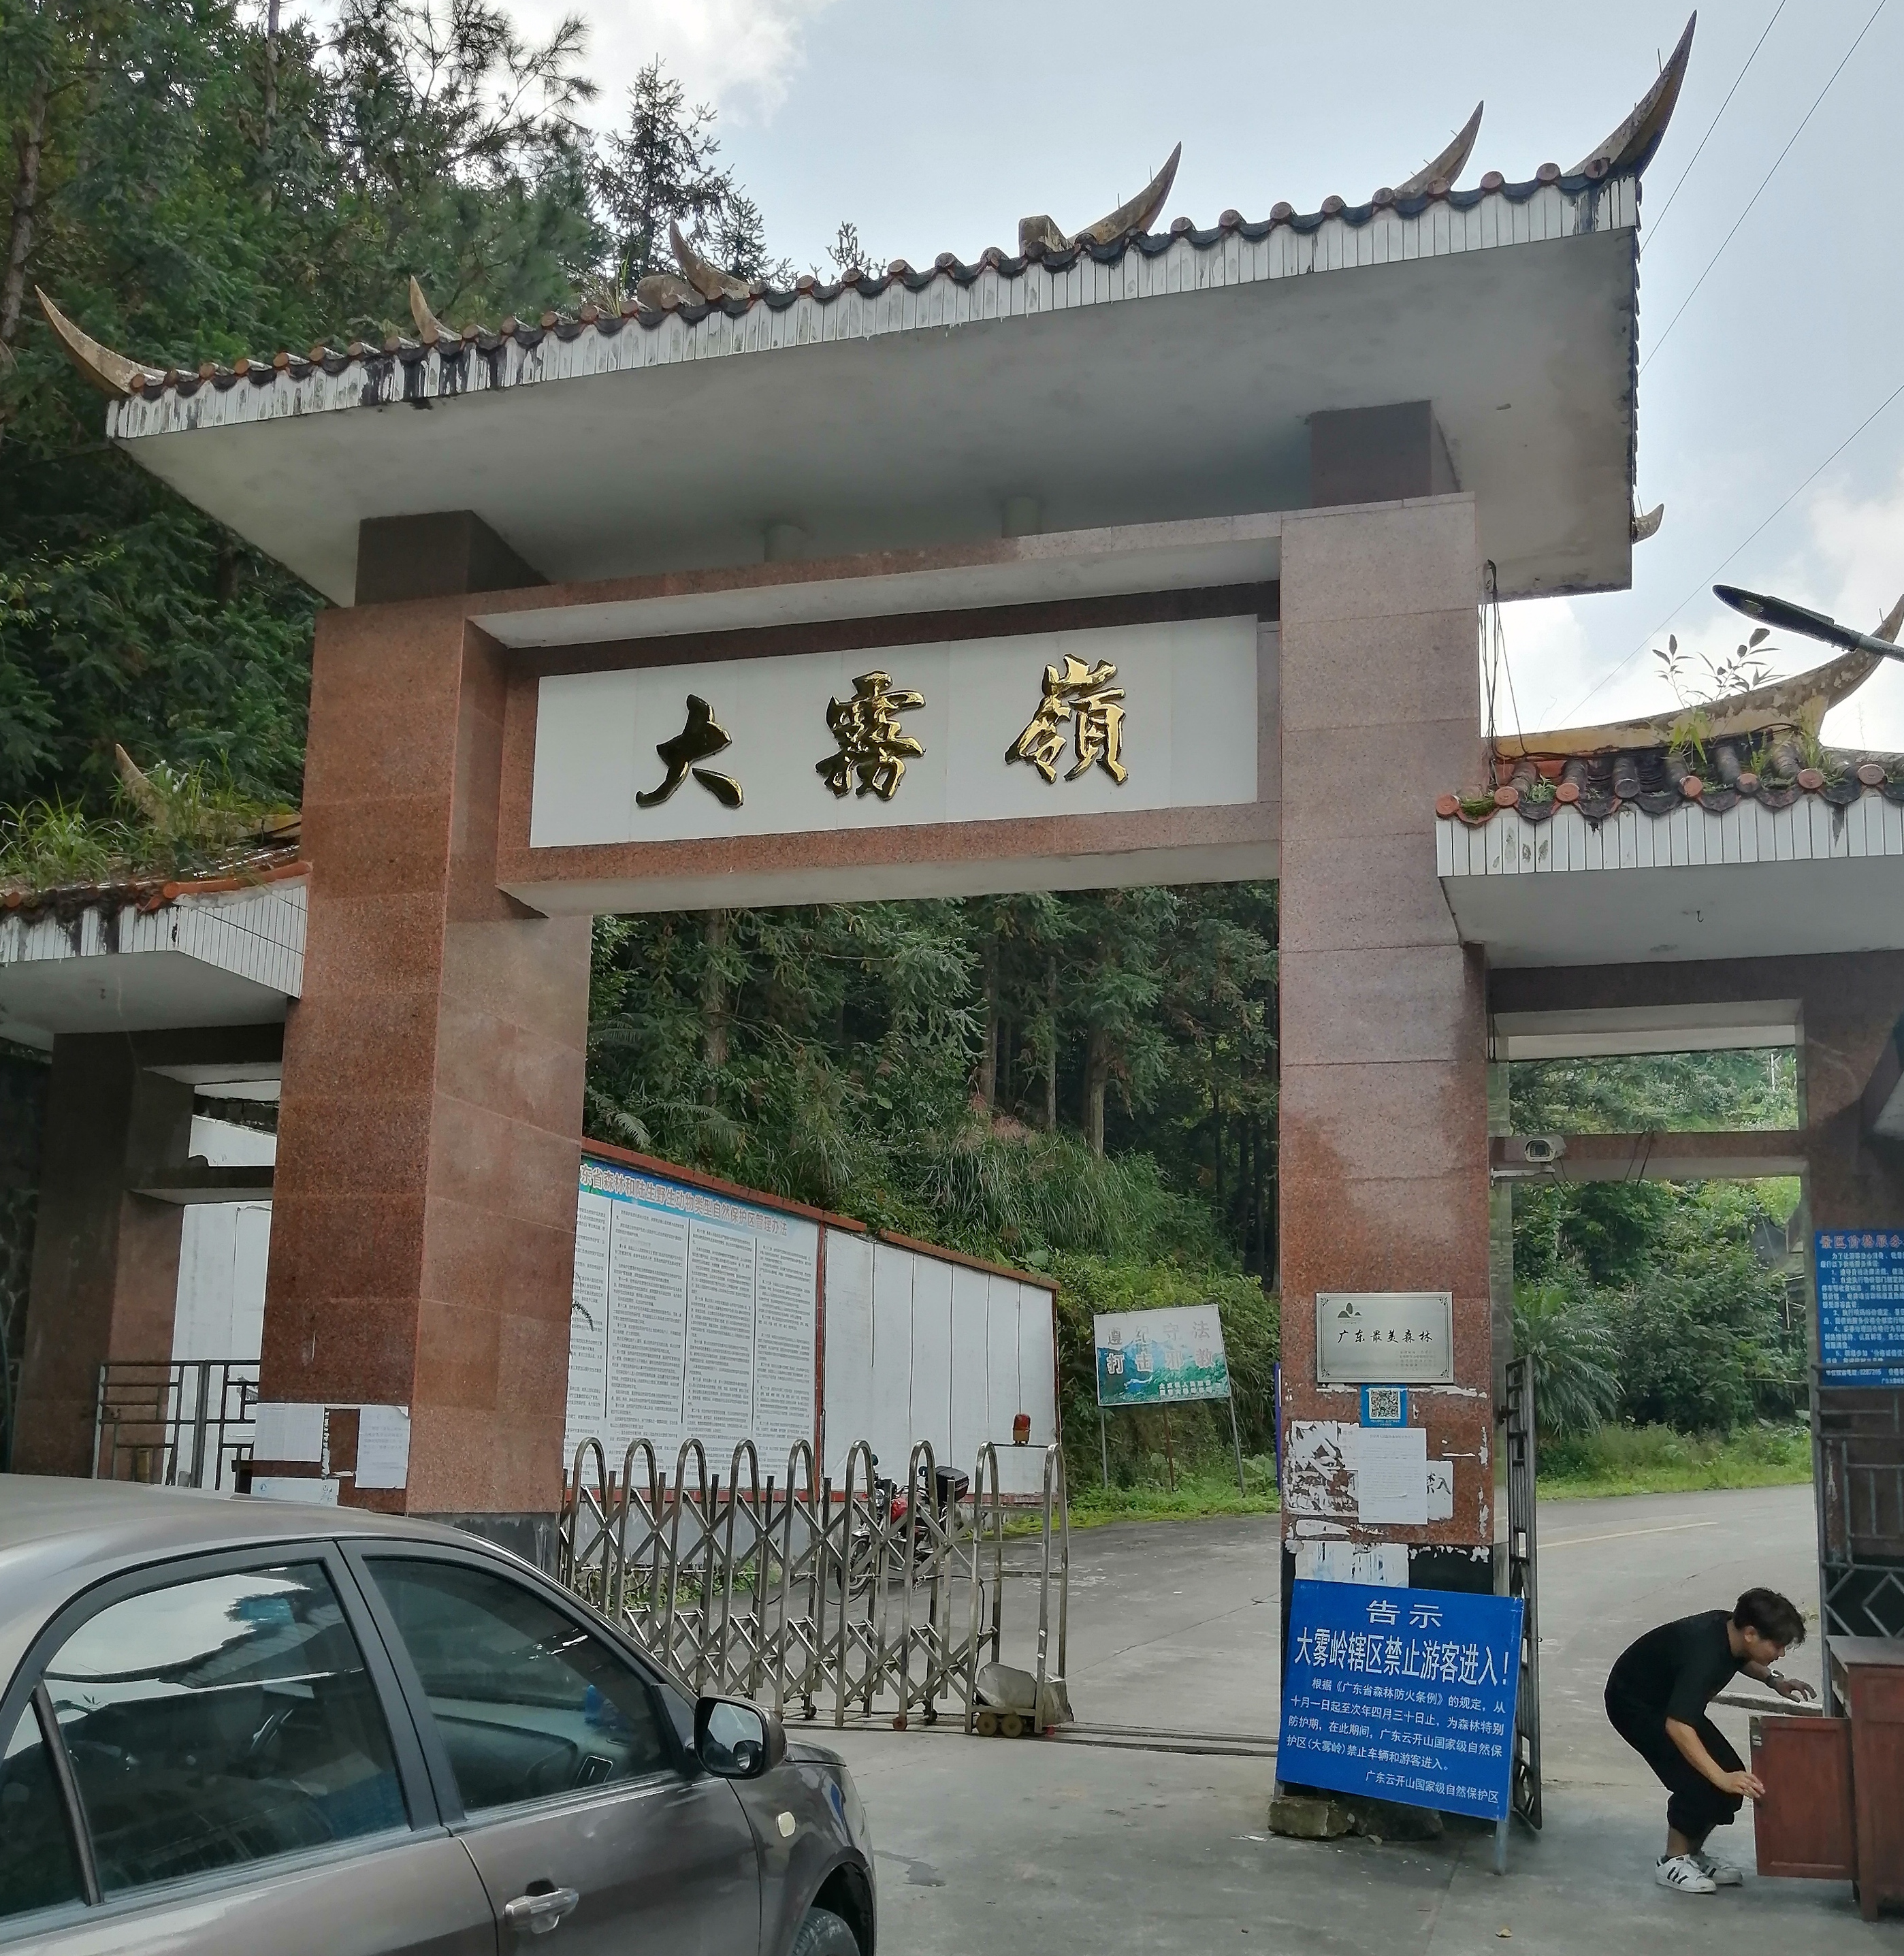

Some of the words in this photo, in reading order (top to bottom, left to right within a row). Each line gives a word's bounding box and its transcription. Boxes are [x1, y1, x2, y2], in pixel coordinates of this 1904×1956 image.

[1338, 1328, 1433, 1344] 广东最美森林
[1106, 1348, 1216, 1375] 打击邪教
[1366, 1600, 1443, 1629] 告示
[1366, 1771, 1499, 1803] 广东云开山国家级自然保护区
